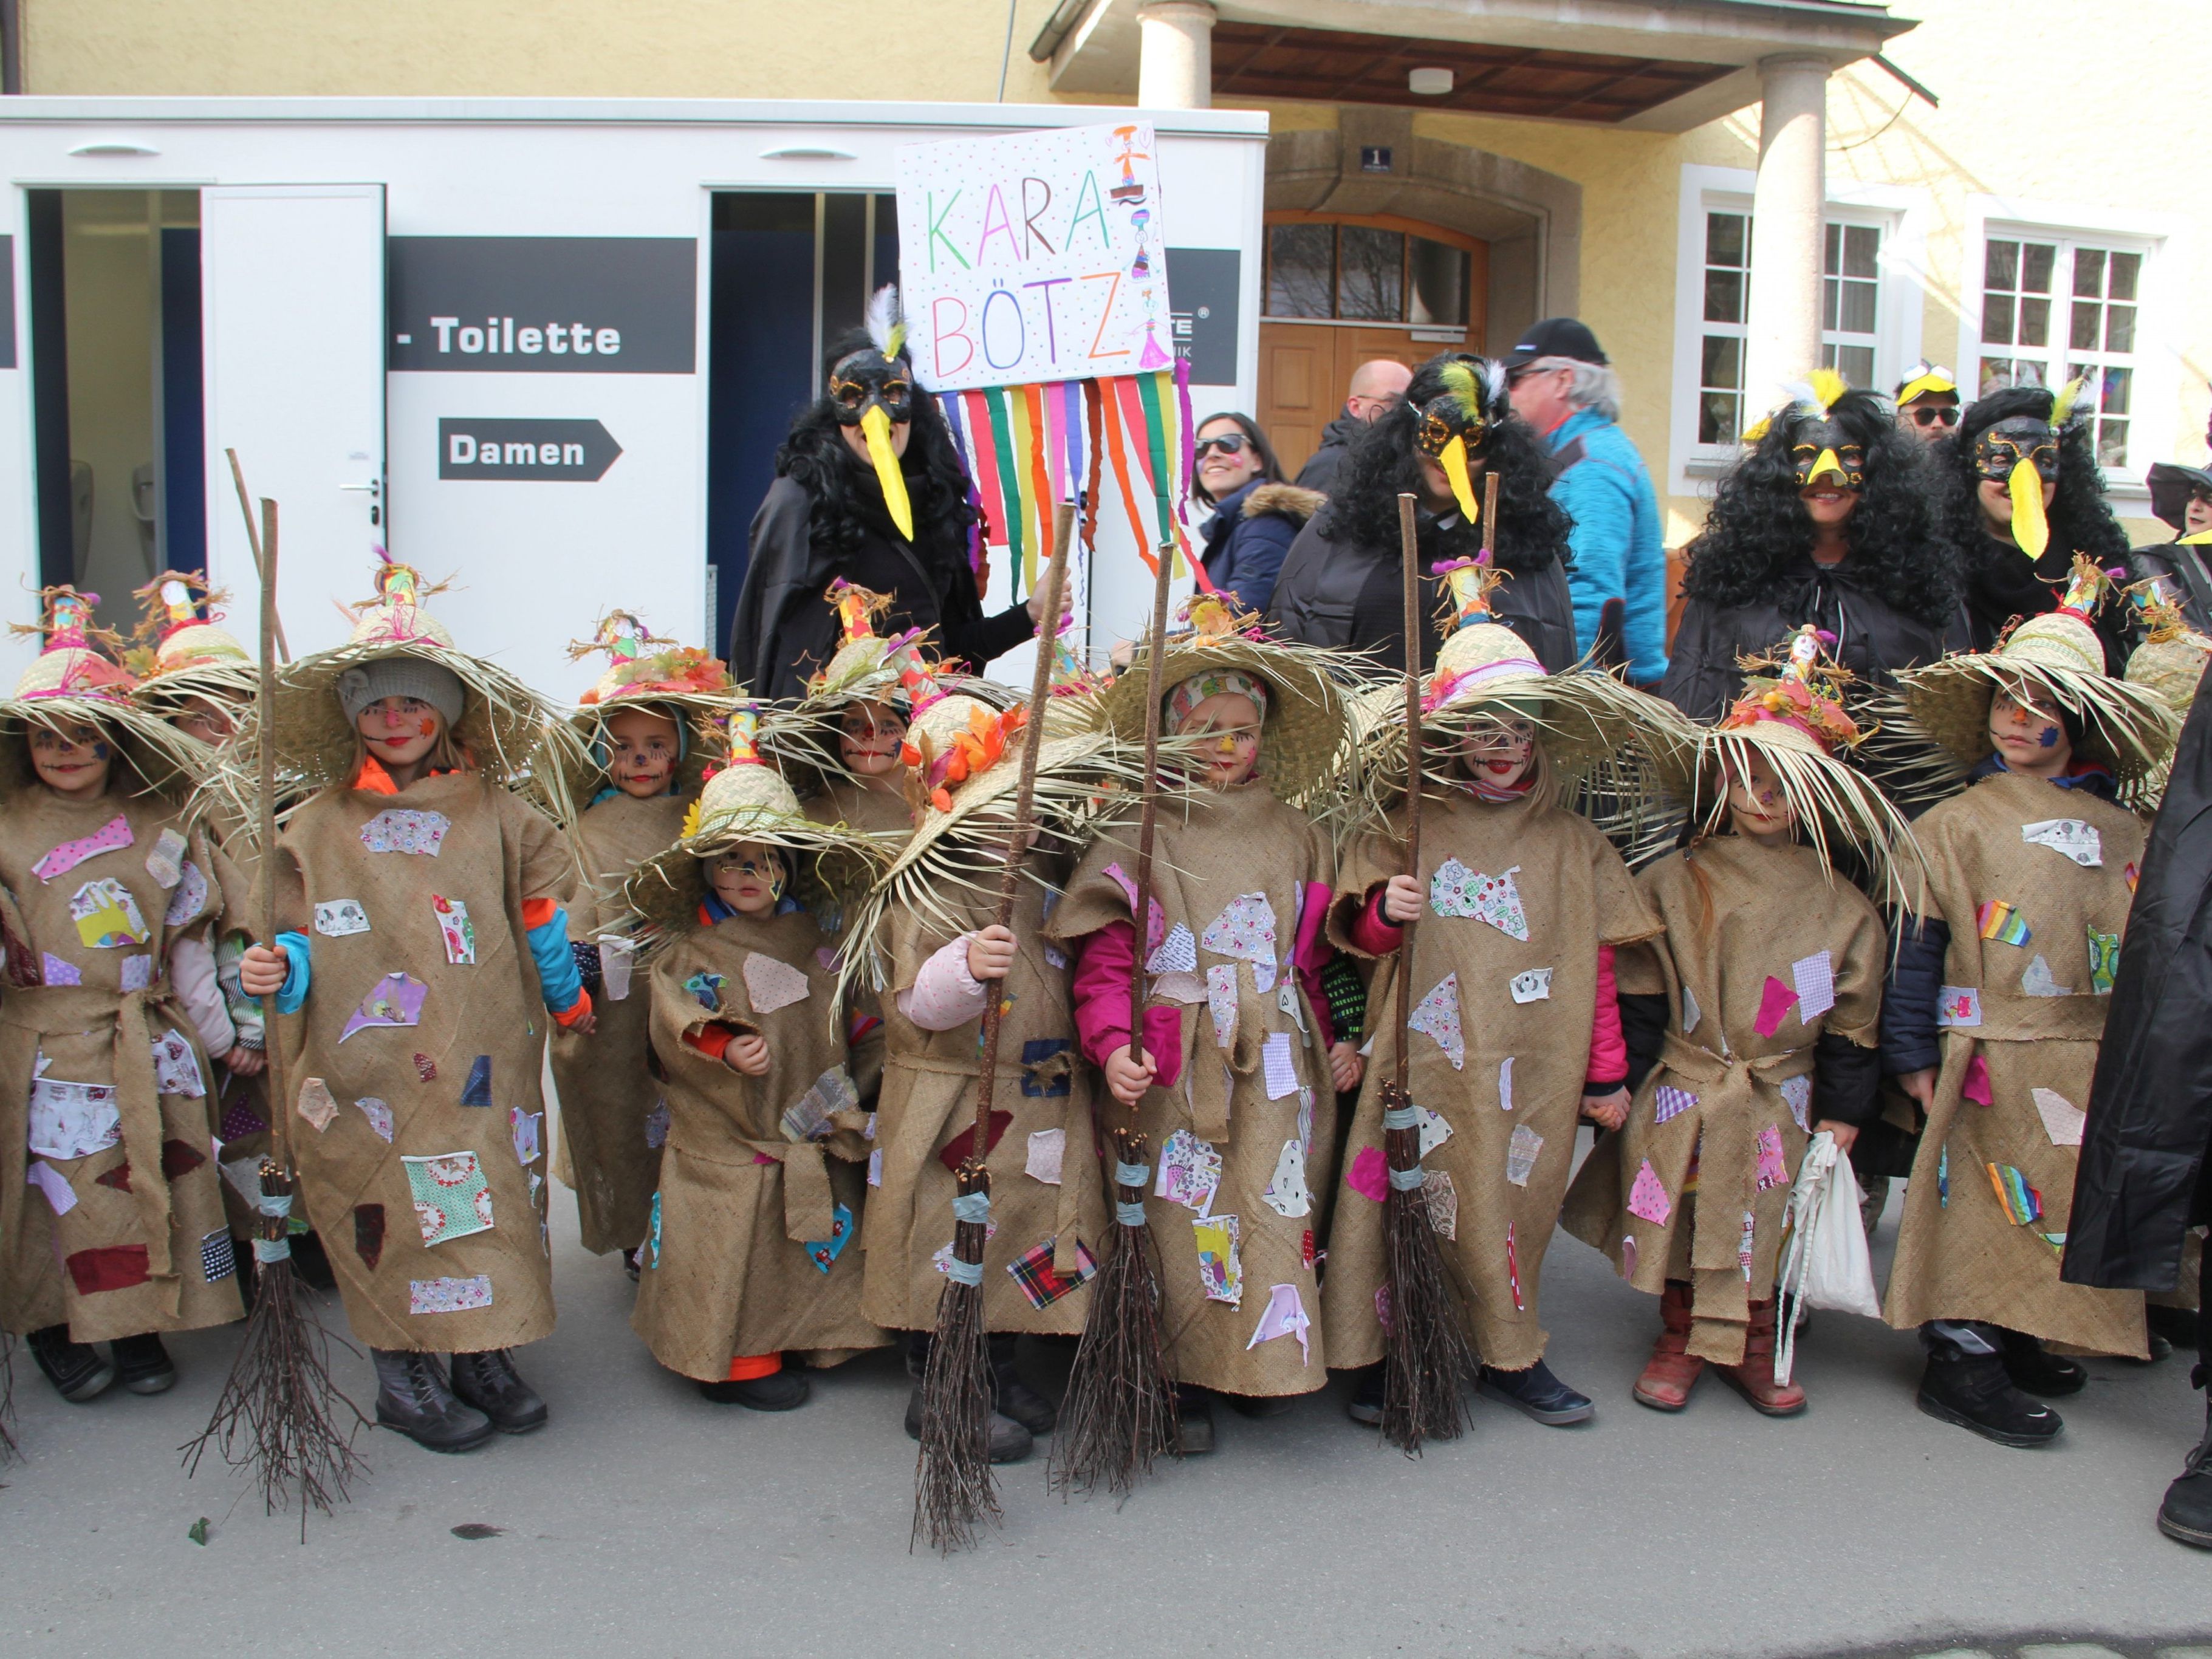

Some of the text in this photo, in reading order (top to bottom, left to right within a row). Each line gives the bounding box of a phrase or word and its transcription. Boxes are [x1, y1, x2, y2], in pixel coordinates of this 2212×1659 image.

[1372, 149, 1380, 165] 1
[928, 170, 1110, 272] KARA
[431, 317, 621, 355] Toilette
[933, 272, 1131, 378] BÖTZ
[450, 434, 585, 466] Damen
